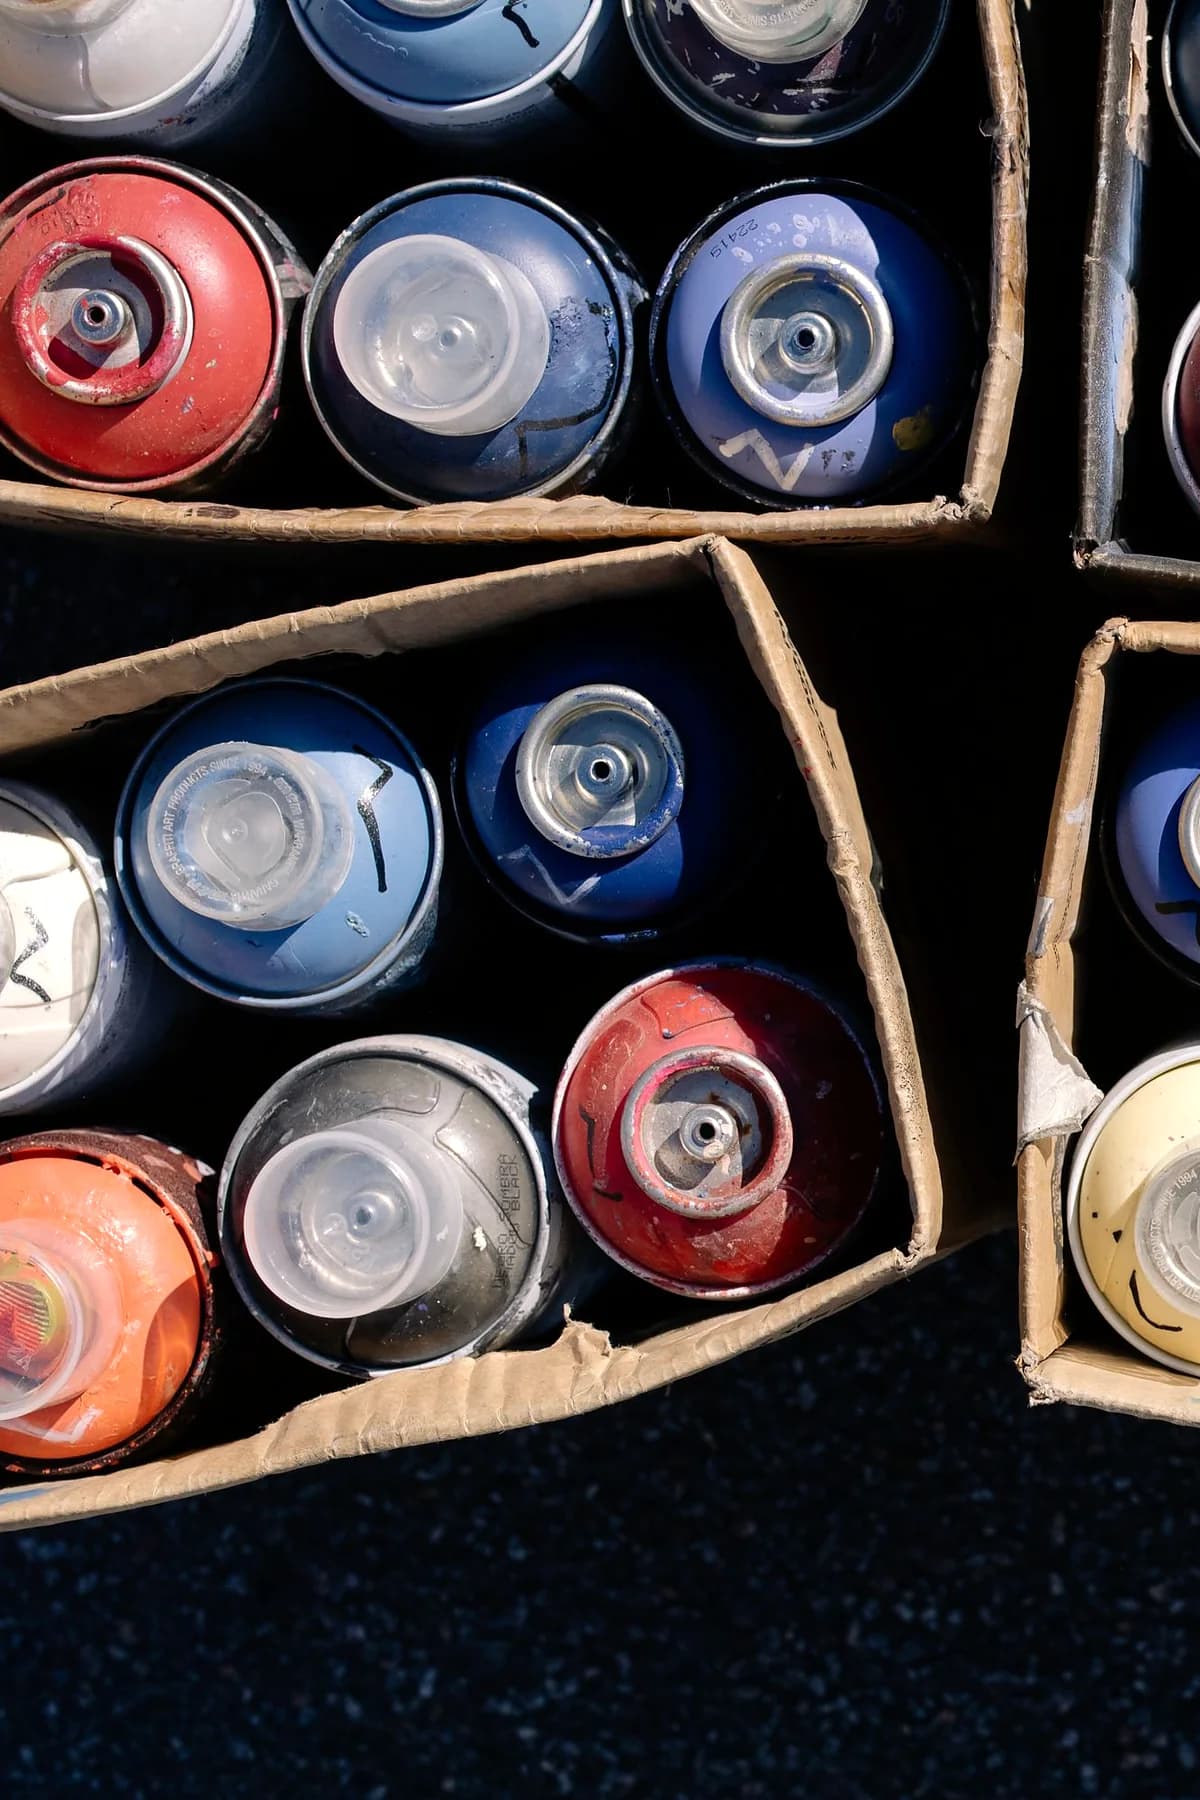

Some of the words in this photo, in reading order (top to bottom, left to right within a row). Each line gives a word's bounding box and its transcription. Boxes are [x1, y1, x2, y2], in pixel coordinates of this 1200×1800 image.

[162, 809, 175, 831] ART
[169, 765, 210, 812] PRODUCTS
[508, 1154, 521, 1211] BLACK
[1176, 1170, 1197, 1189] 1994
